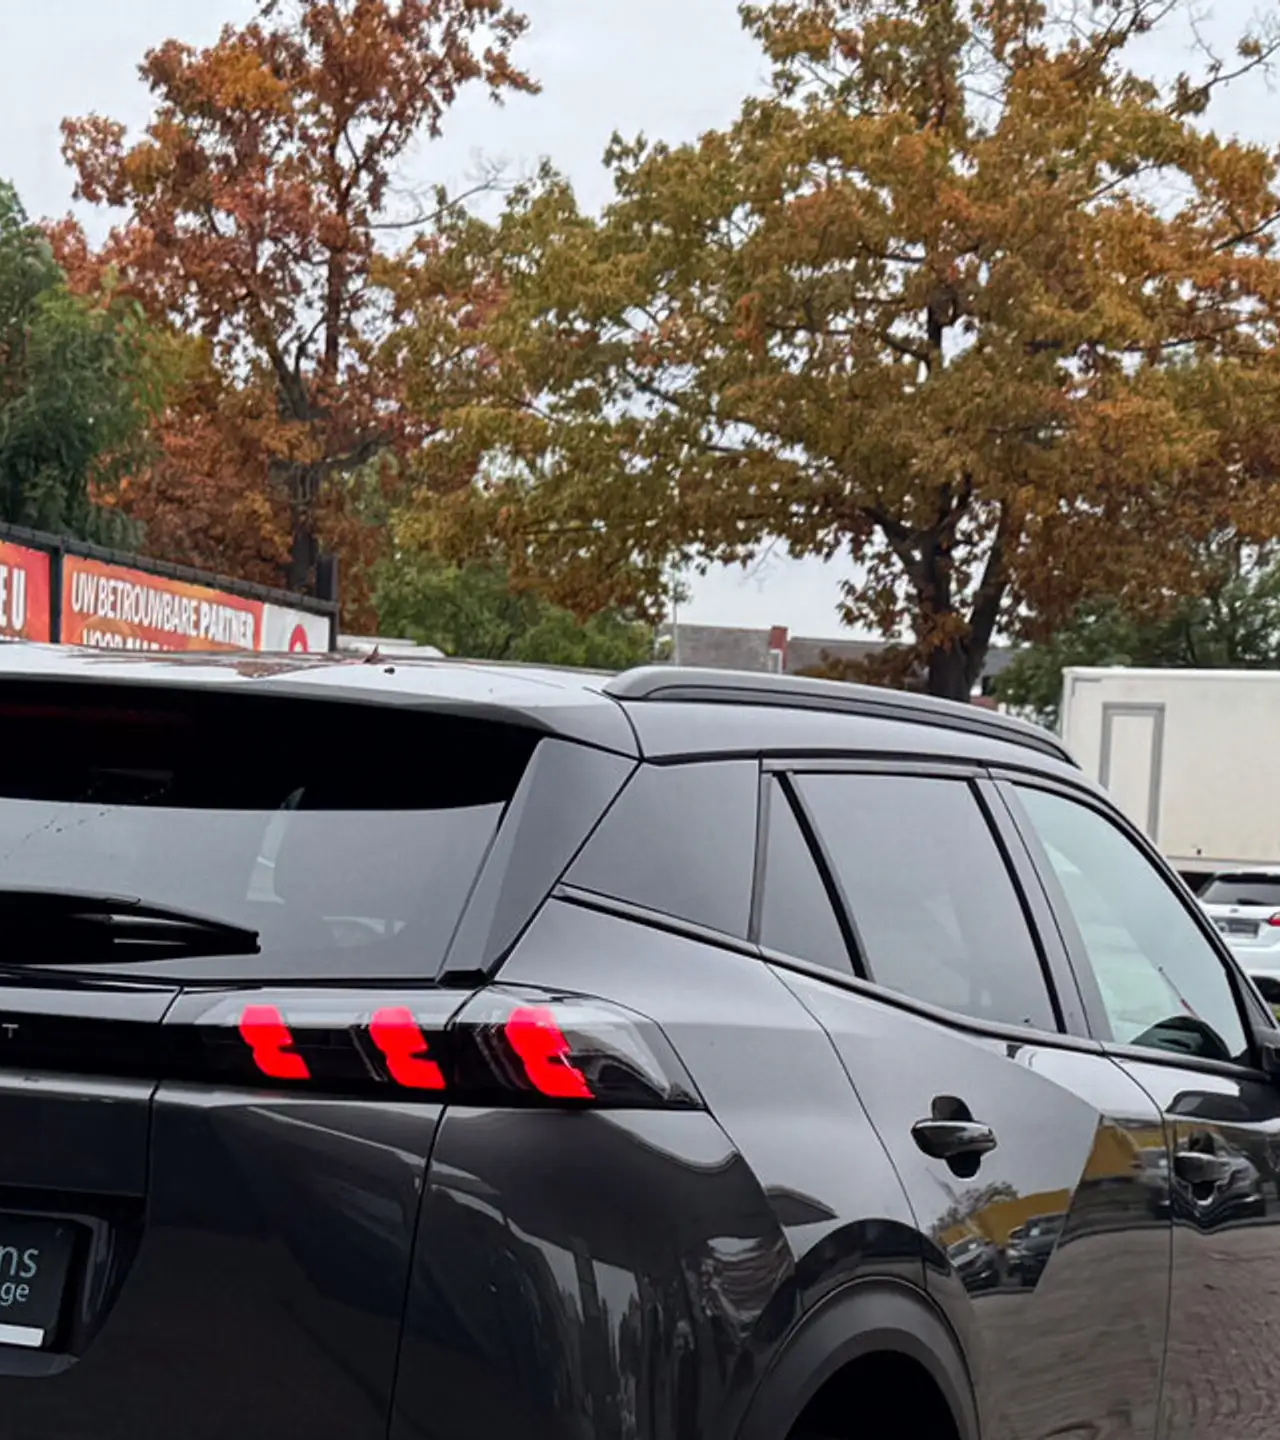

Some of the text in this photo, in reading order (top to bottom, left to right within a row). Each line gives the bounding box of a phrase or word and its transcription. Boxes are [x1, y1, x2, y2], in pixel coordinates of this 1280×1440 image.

[11, 567, 26, 631] U
[71, 571, 99, 614] UW
[98, 576, 199, 637] BETROUWBARE
[198, 599, 256, 650] PARTNER
